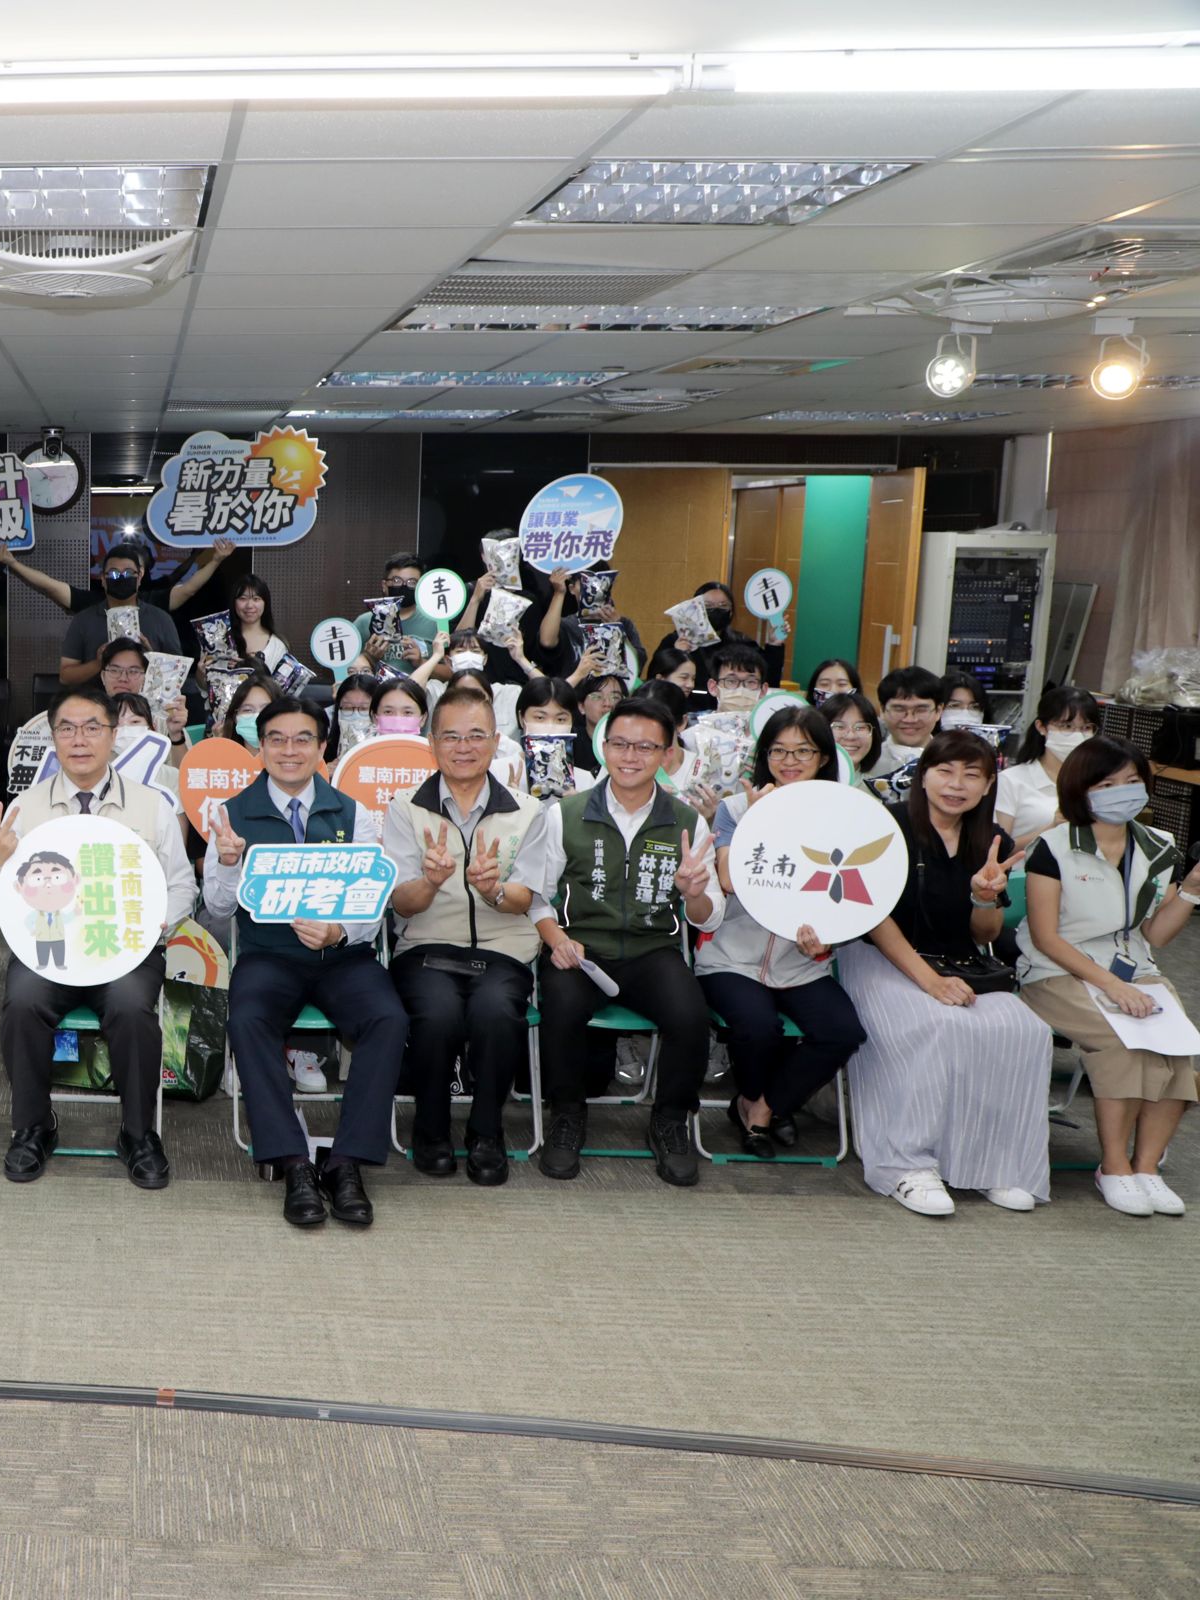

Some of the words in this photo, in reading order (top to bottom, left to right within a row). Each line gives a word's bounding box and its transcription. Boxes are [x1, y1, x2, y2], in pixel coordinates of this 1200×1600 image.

[181, 458, 274, 490] 新力量
[168, 489, 295, 532] 暑於你
[527, 510, 579, 528] 讓專業
[524, 530, 613, 560] 帶你飛
[432, 576, 450, 614] 青
[753, 577, 781, 610] 青
[320, 626, 351, 661] 青
[187, 768, 261, 790] 臺南社
[358, 766, 440, 785] 臺南市政
[250, 852, 377, 876] 臺南市政府
[744, 842, 797, 878] 臺南
[79, 843, 122, 957] 讚出來
[119, 843, 146, 952] 臺南青年
[259, 878, 388, 915] 研考會
[747, 877, 792, 890] TAINAN
